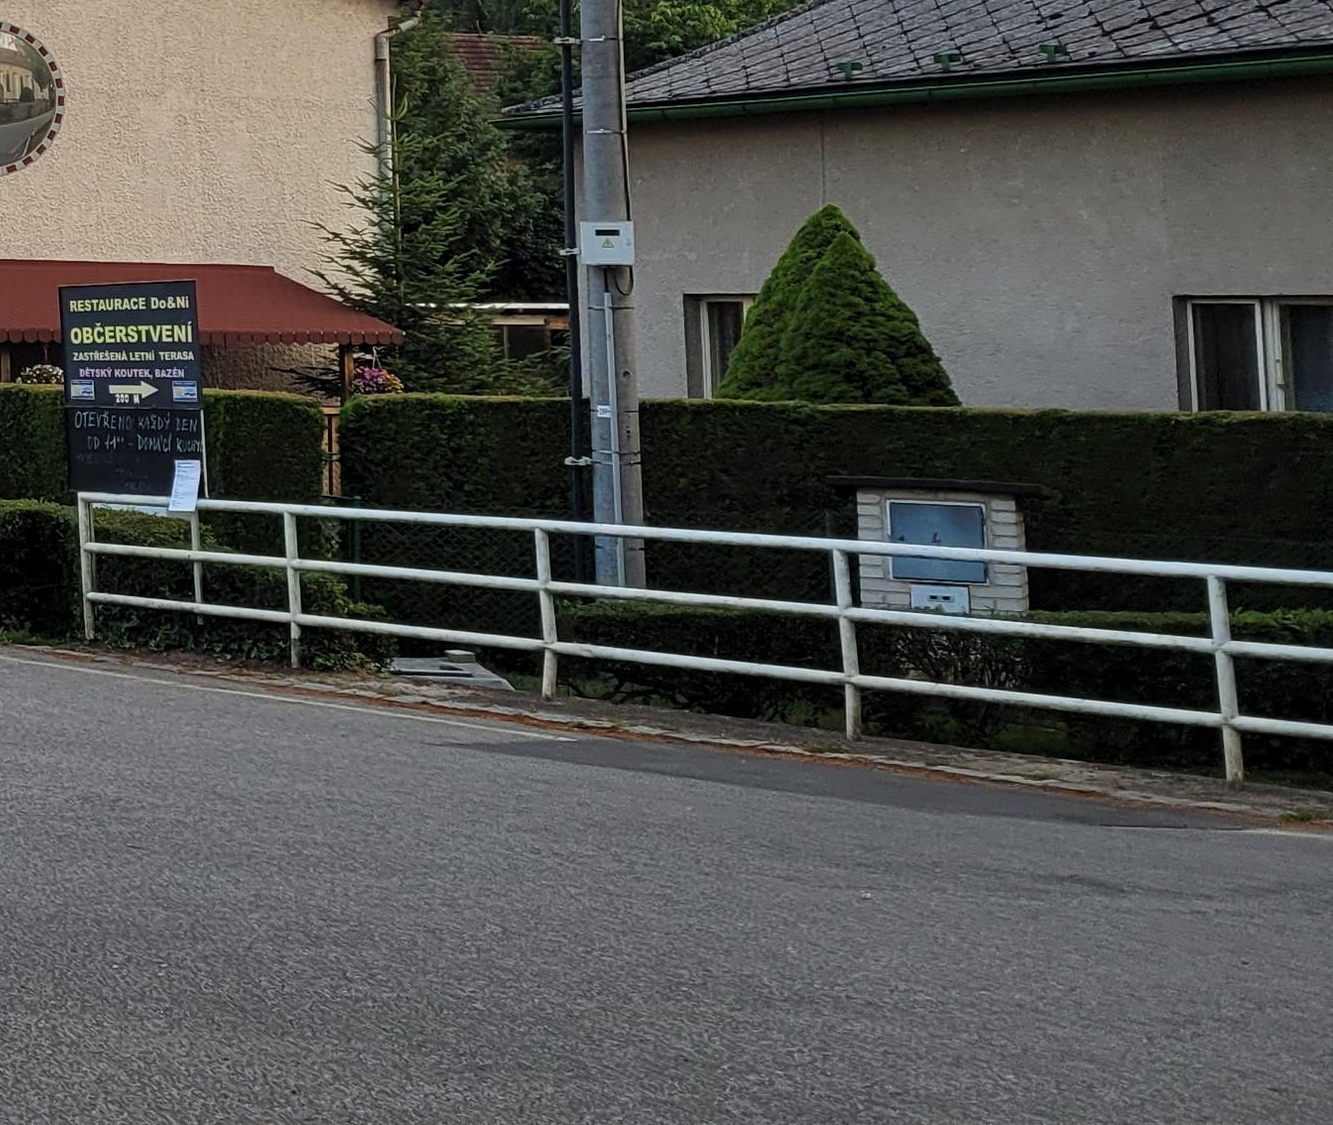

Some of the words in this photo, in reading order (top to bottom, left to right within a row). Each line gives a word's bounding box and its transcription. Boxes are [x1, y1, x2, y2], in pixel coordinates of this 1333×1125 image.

[69, 297, 146, 312] RESTAURACE
[150, 296, 189, 309] Do&Ni
[70, 321, 193, 344] OBČERSTVENÍ
[73, 350, 128, 361] ZASTŘEŠENÁ
[129, 350, 155, 361] LETNÍ
[158, 351, 194, 361] TERASA
[79, 367, 112, 377] DĚTSKÝ
[114, 369, 152, 379] KOUTEK,
[155, 368, 184, 378] BAZÉN
